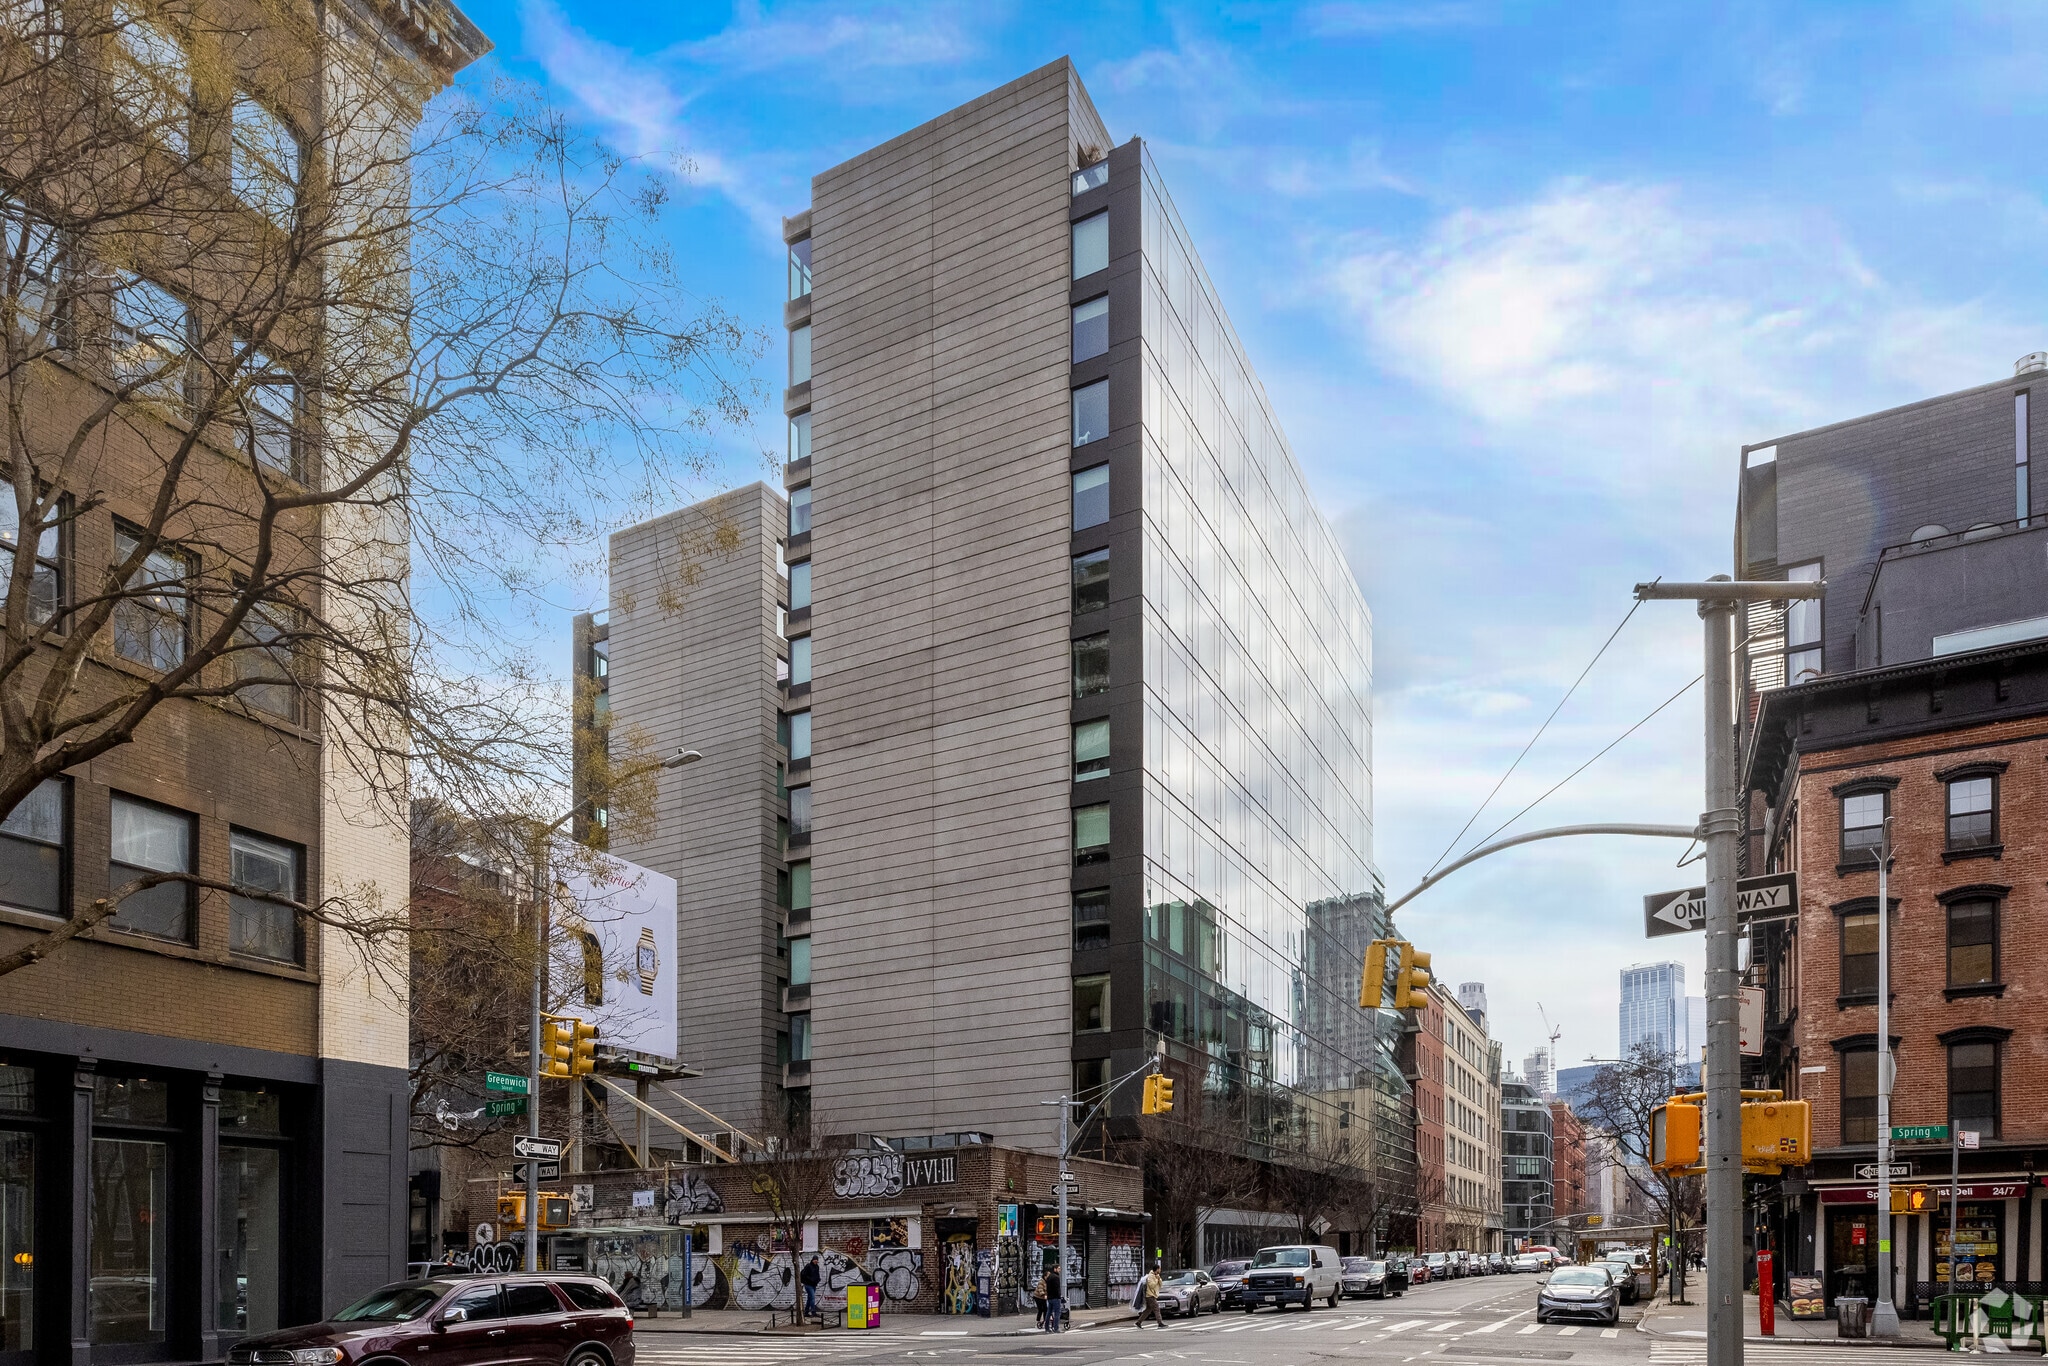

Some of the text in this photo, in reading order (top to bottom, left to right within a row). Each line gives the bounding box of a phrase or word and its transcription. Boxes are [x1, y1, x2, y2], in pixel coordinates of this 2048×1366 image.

[1737, 888, 1780, 911] WAY
[487, 1074, 527, 1088] Greenwich
[491, 1101, 515, 1115] Spring
[1898, 1127, 1931, 1139] Spring
[520, 1142, 557, 1154] ONE WAY
[541, 1167, 555, 1176] WAY
[1863, 1168, 1879, 1176] ONE
[1992, 1186, 2016, 1196] 24/7
